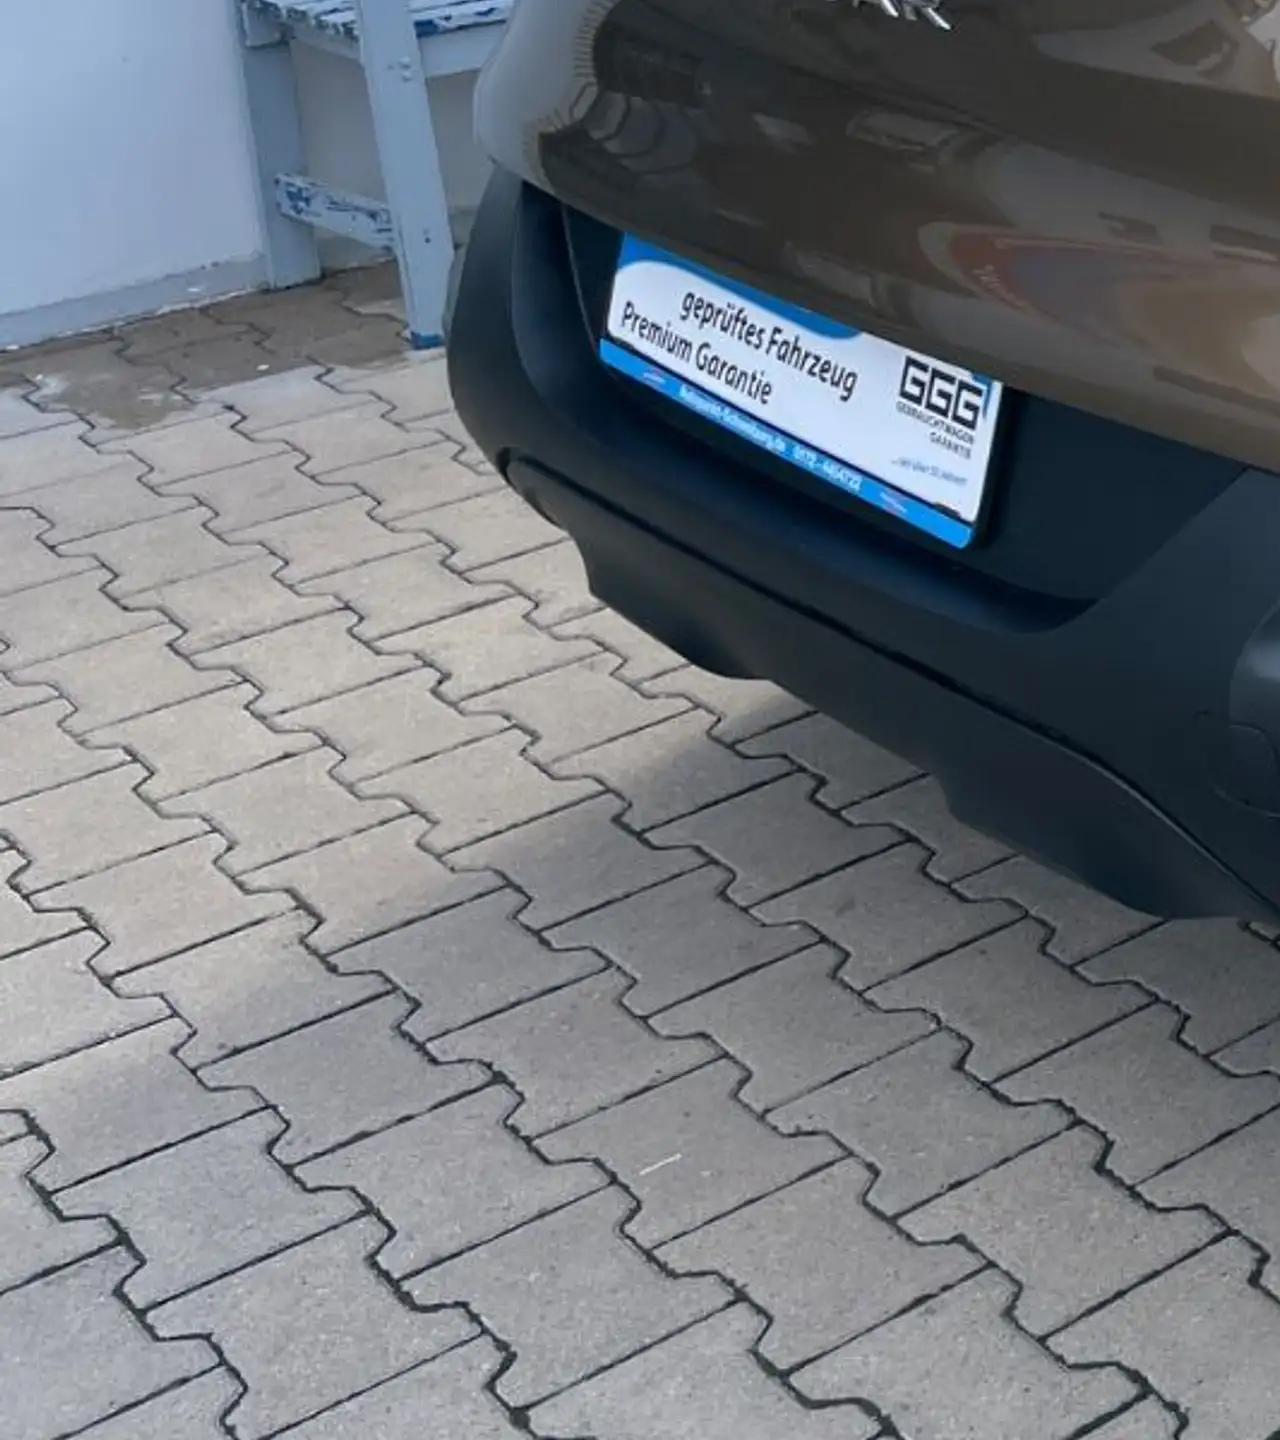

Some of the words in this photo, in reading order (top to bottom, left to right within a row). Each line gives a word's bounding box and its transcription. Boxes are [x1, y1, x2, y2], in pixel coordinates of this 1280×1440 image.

[621, 300, 693, 362] Premium
[695, 342, 773, 404] Garantie
[680, 292, 763, 349] geprüftes
[766, 326, 858, 402] Fahrzeug
[899, 355, 983, 430] GGG
